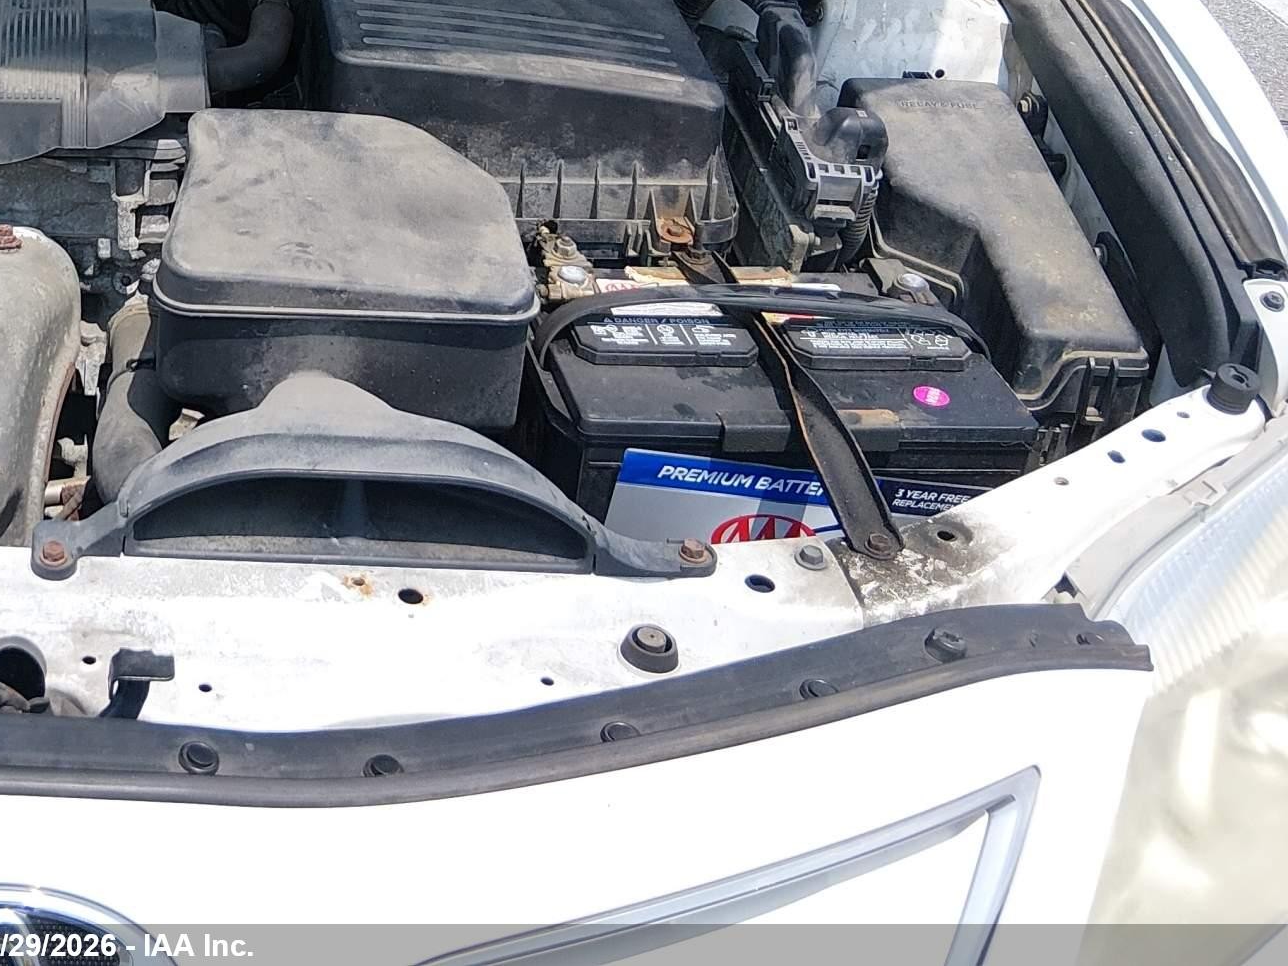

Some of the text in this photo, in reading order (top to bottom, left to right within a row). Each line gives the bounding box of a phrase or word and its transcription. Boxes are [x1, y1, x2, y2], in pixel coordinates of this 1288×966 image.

[669, 317, 710, 325] POISON
[657, 465, 756, 489] PREMIUM
[895, 488, 972, 505] 3 YEAR FREE
